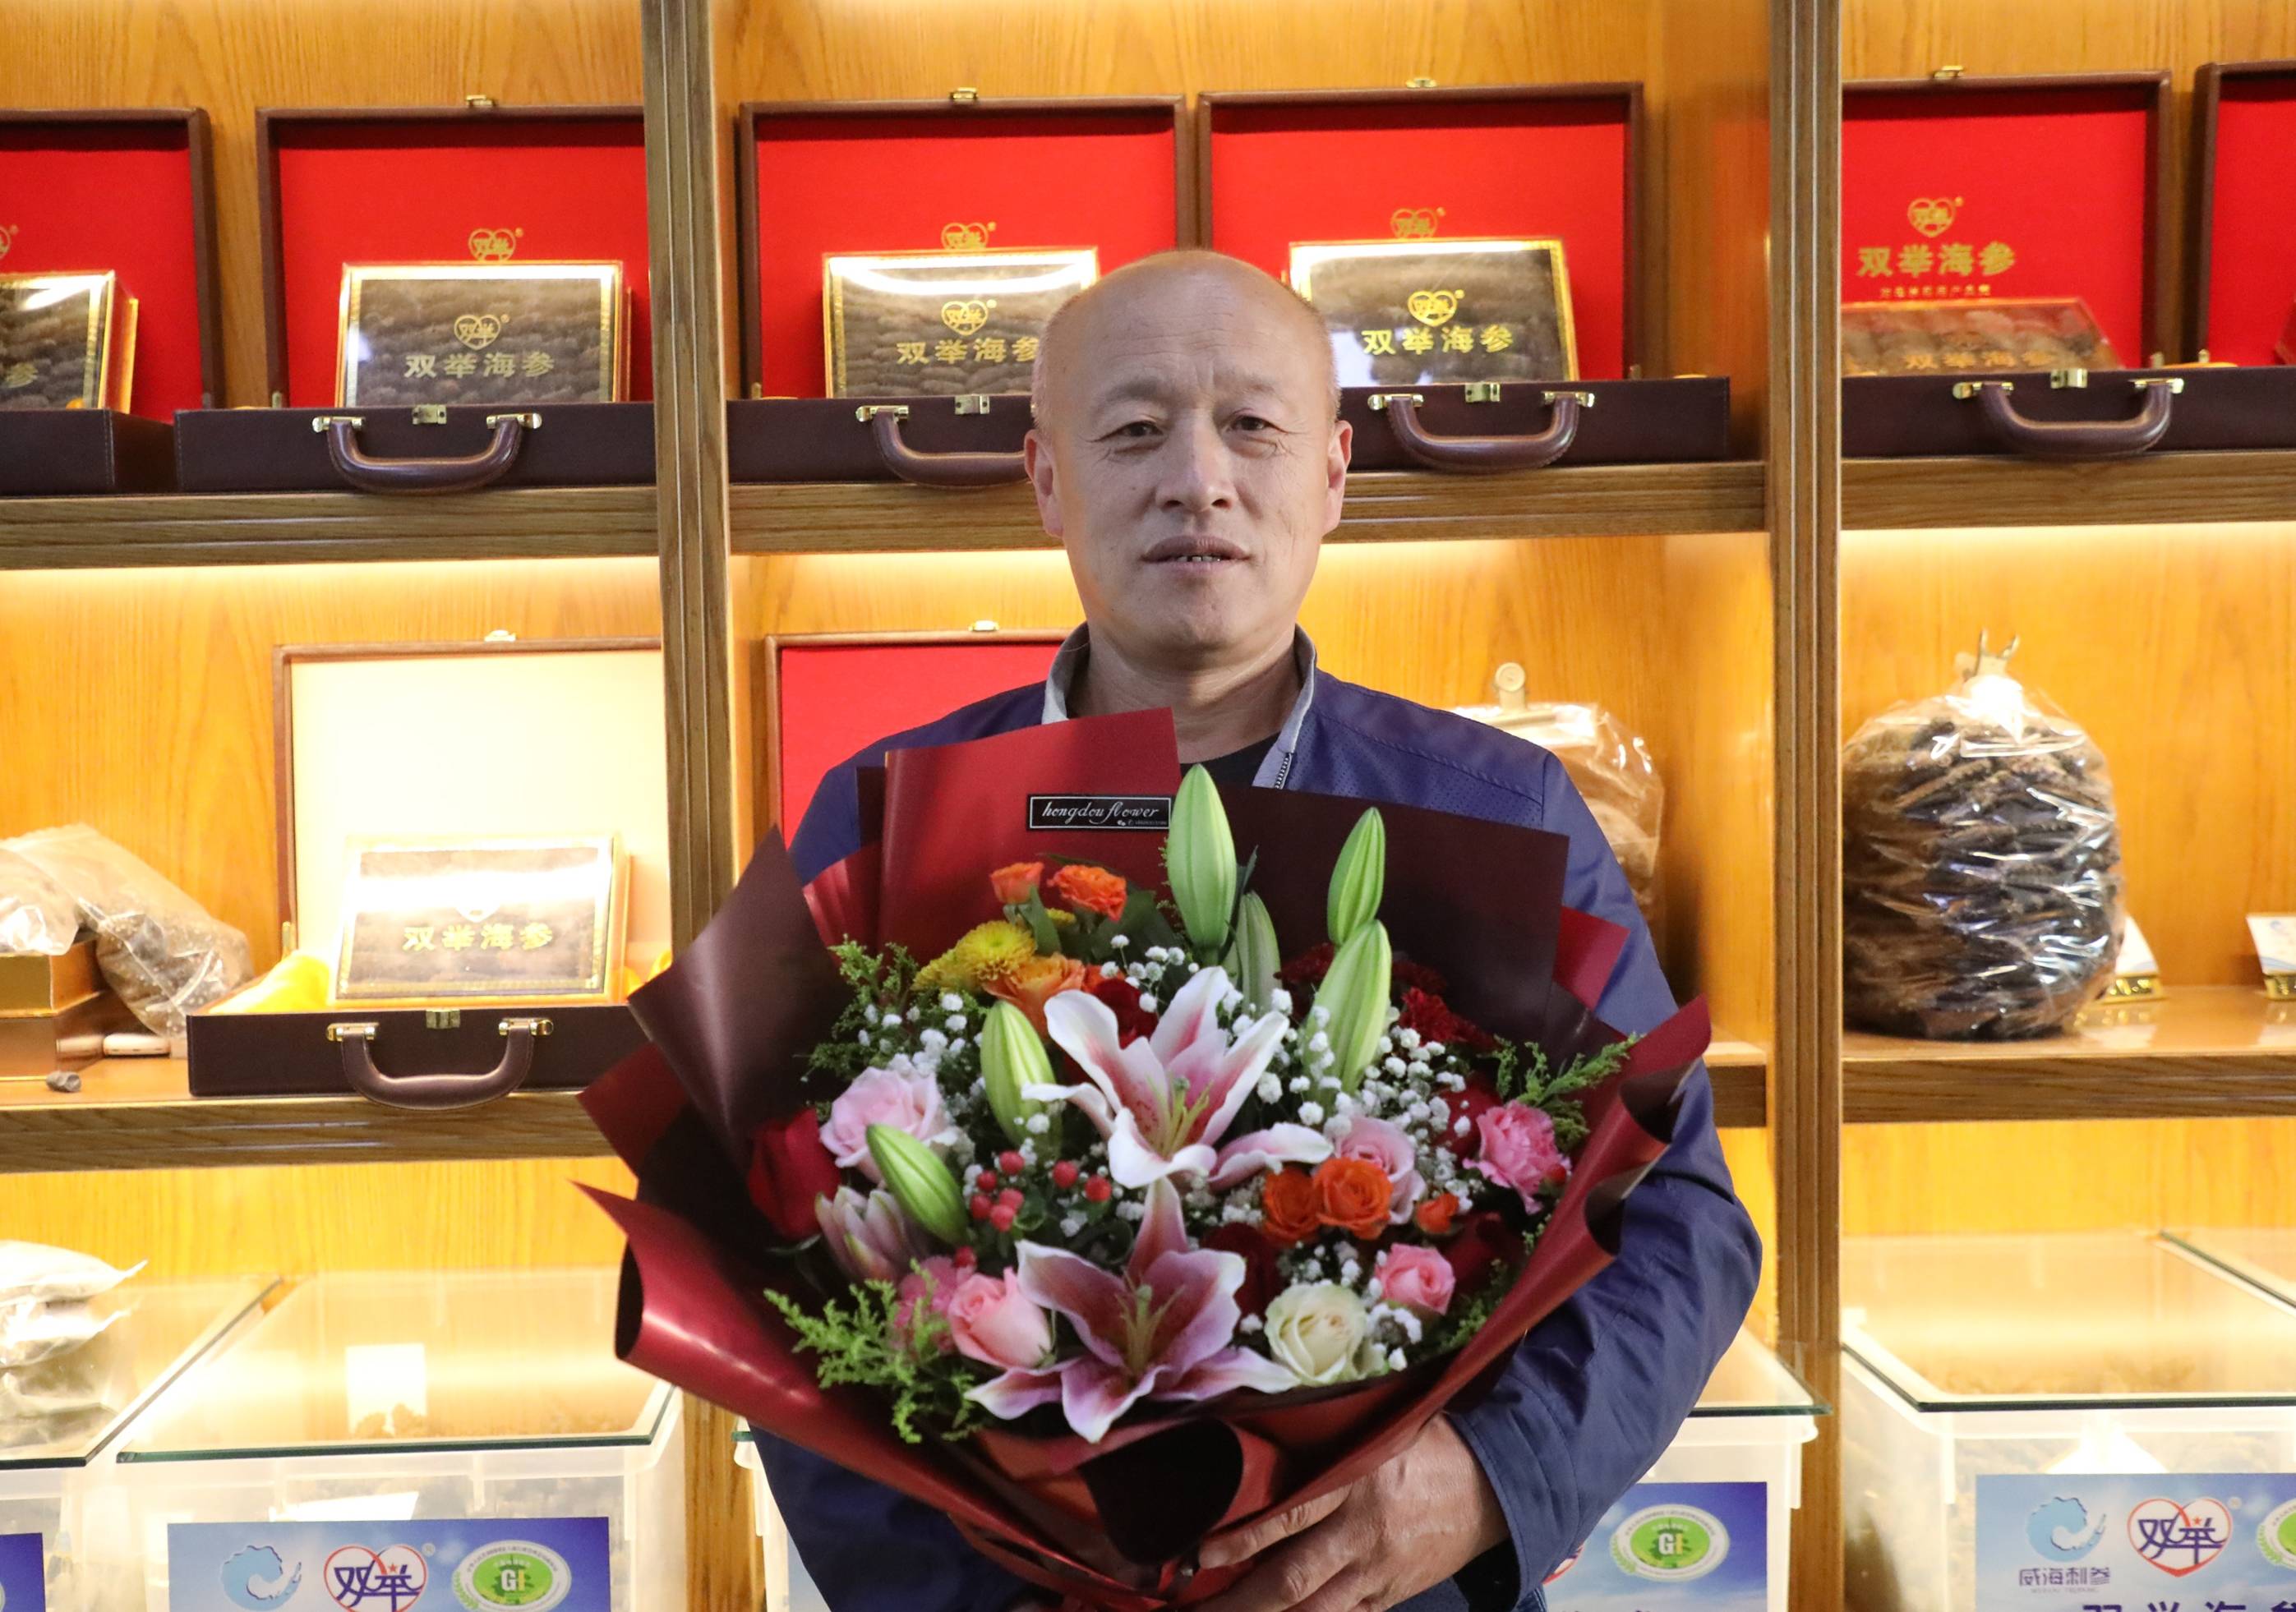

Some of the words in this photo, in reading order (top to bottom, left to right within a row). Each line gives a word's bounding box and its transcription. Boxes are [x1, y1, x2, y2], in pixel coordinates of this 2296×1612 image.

[1856, 241, 2015, 277] 双举海参
[896, 335, 1040, 365] 双举海参
[1361, 324, 1513, 356] 双举海参
[404, 351, 555, 379] 双举海参
[1041, 801, 1104, 824] hongdou
[1089, 801, 1160, 825] flower
[402, 922, 553, 951] 双举海参
[1657, 1532, 1684, 1555] GI
[2137, 1513, 2228, 1565] 双举
[333, 1563, 425, 1612] 双举
[500, 1568, 526, 1591] GI
